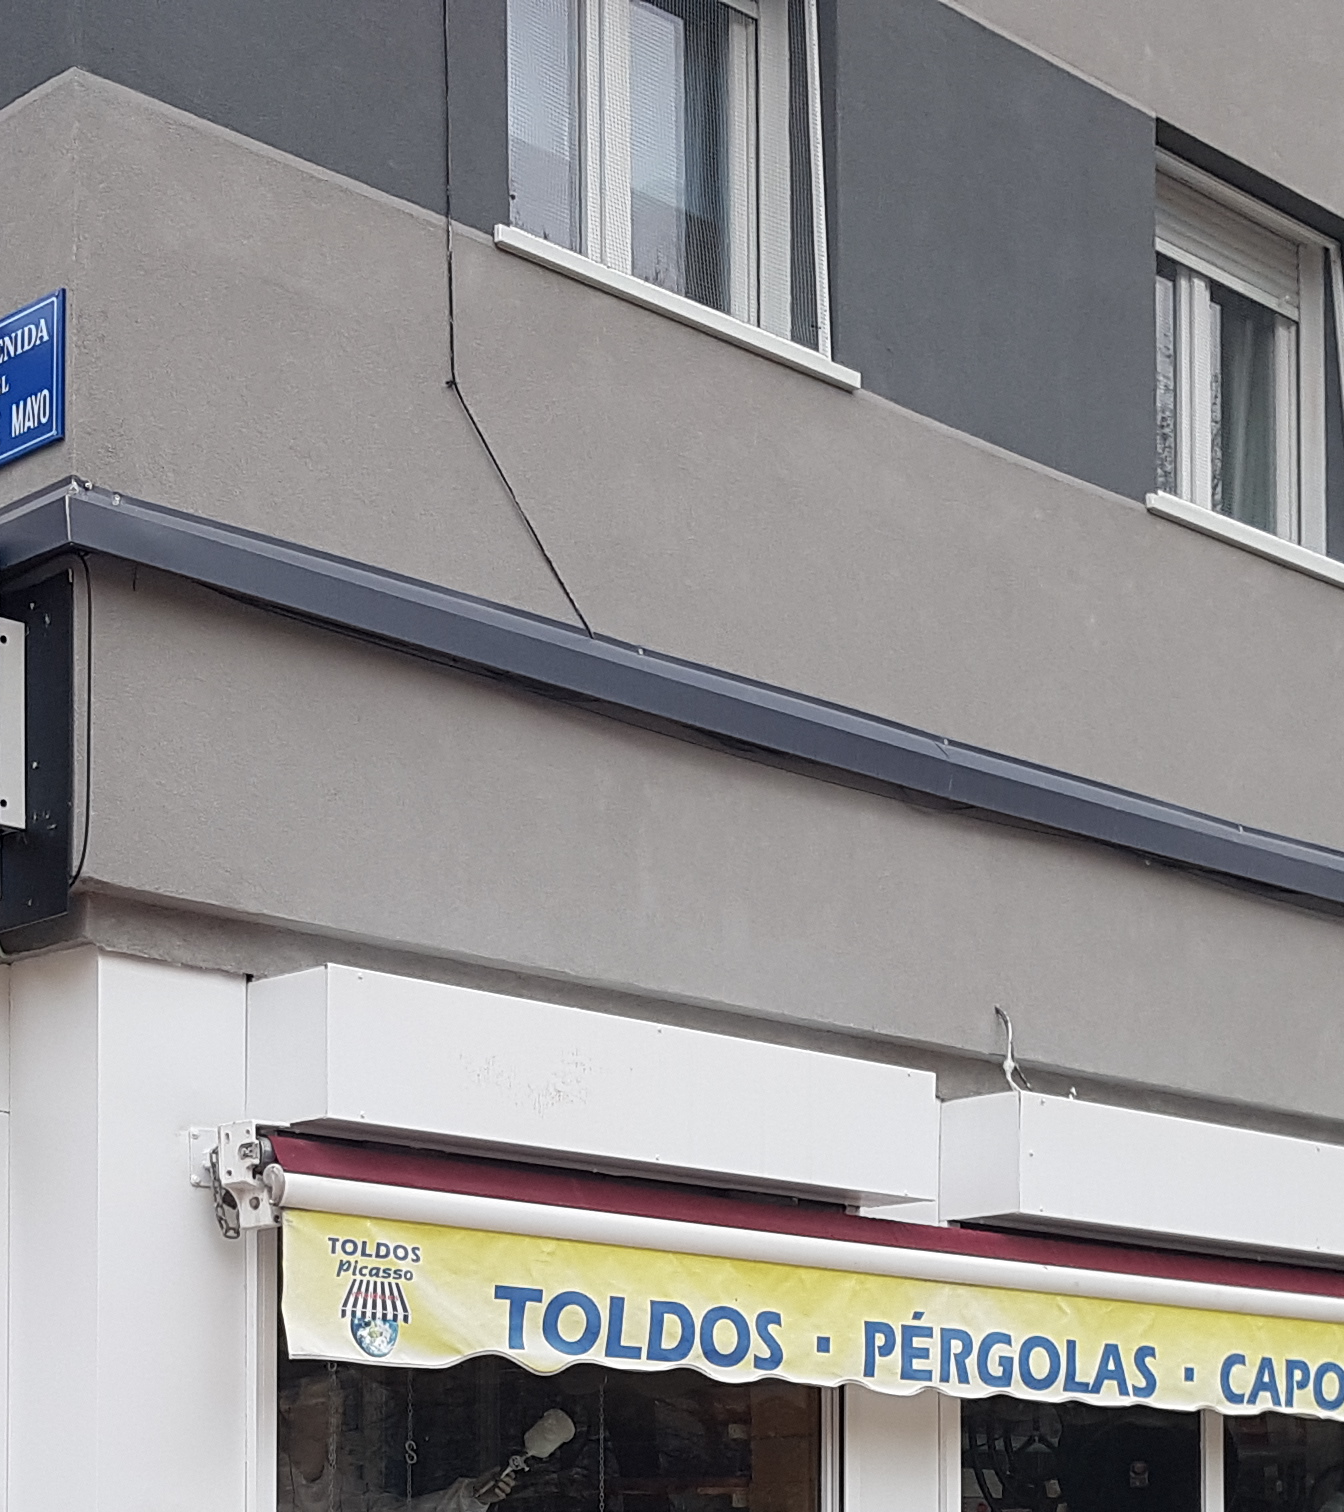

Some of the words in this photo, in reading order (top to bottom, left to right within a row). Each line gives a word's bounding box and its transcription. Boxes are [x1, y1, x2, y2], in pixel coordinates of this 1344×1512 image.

[12, 389, 50, 437] MAYO
[328, 1237, 421, 1263] TOLDOS
[494, 1284, 784, 1371] TOLDOS
[863, 1310, 1158, 1399] PÉRGOLAS
